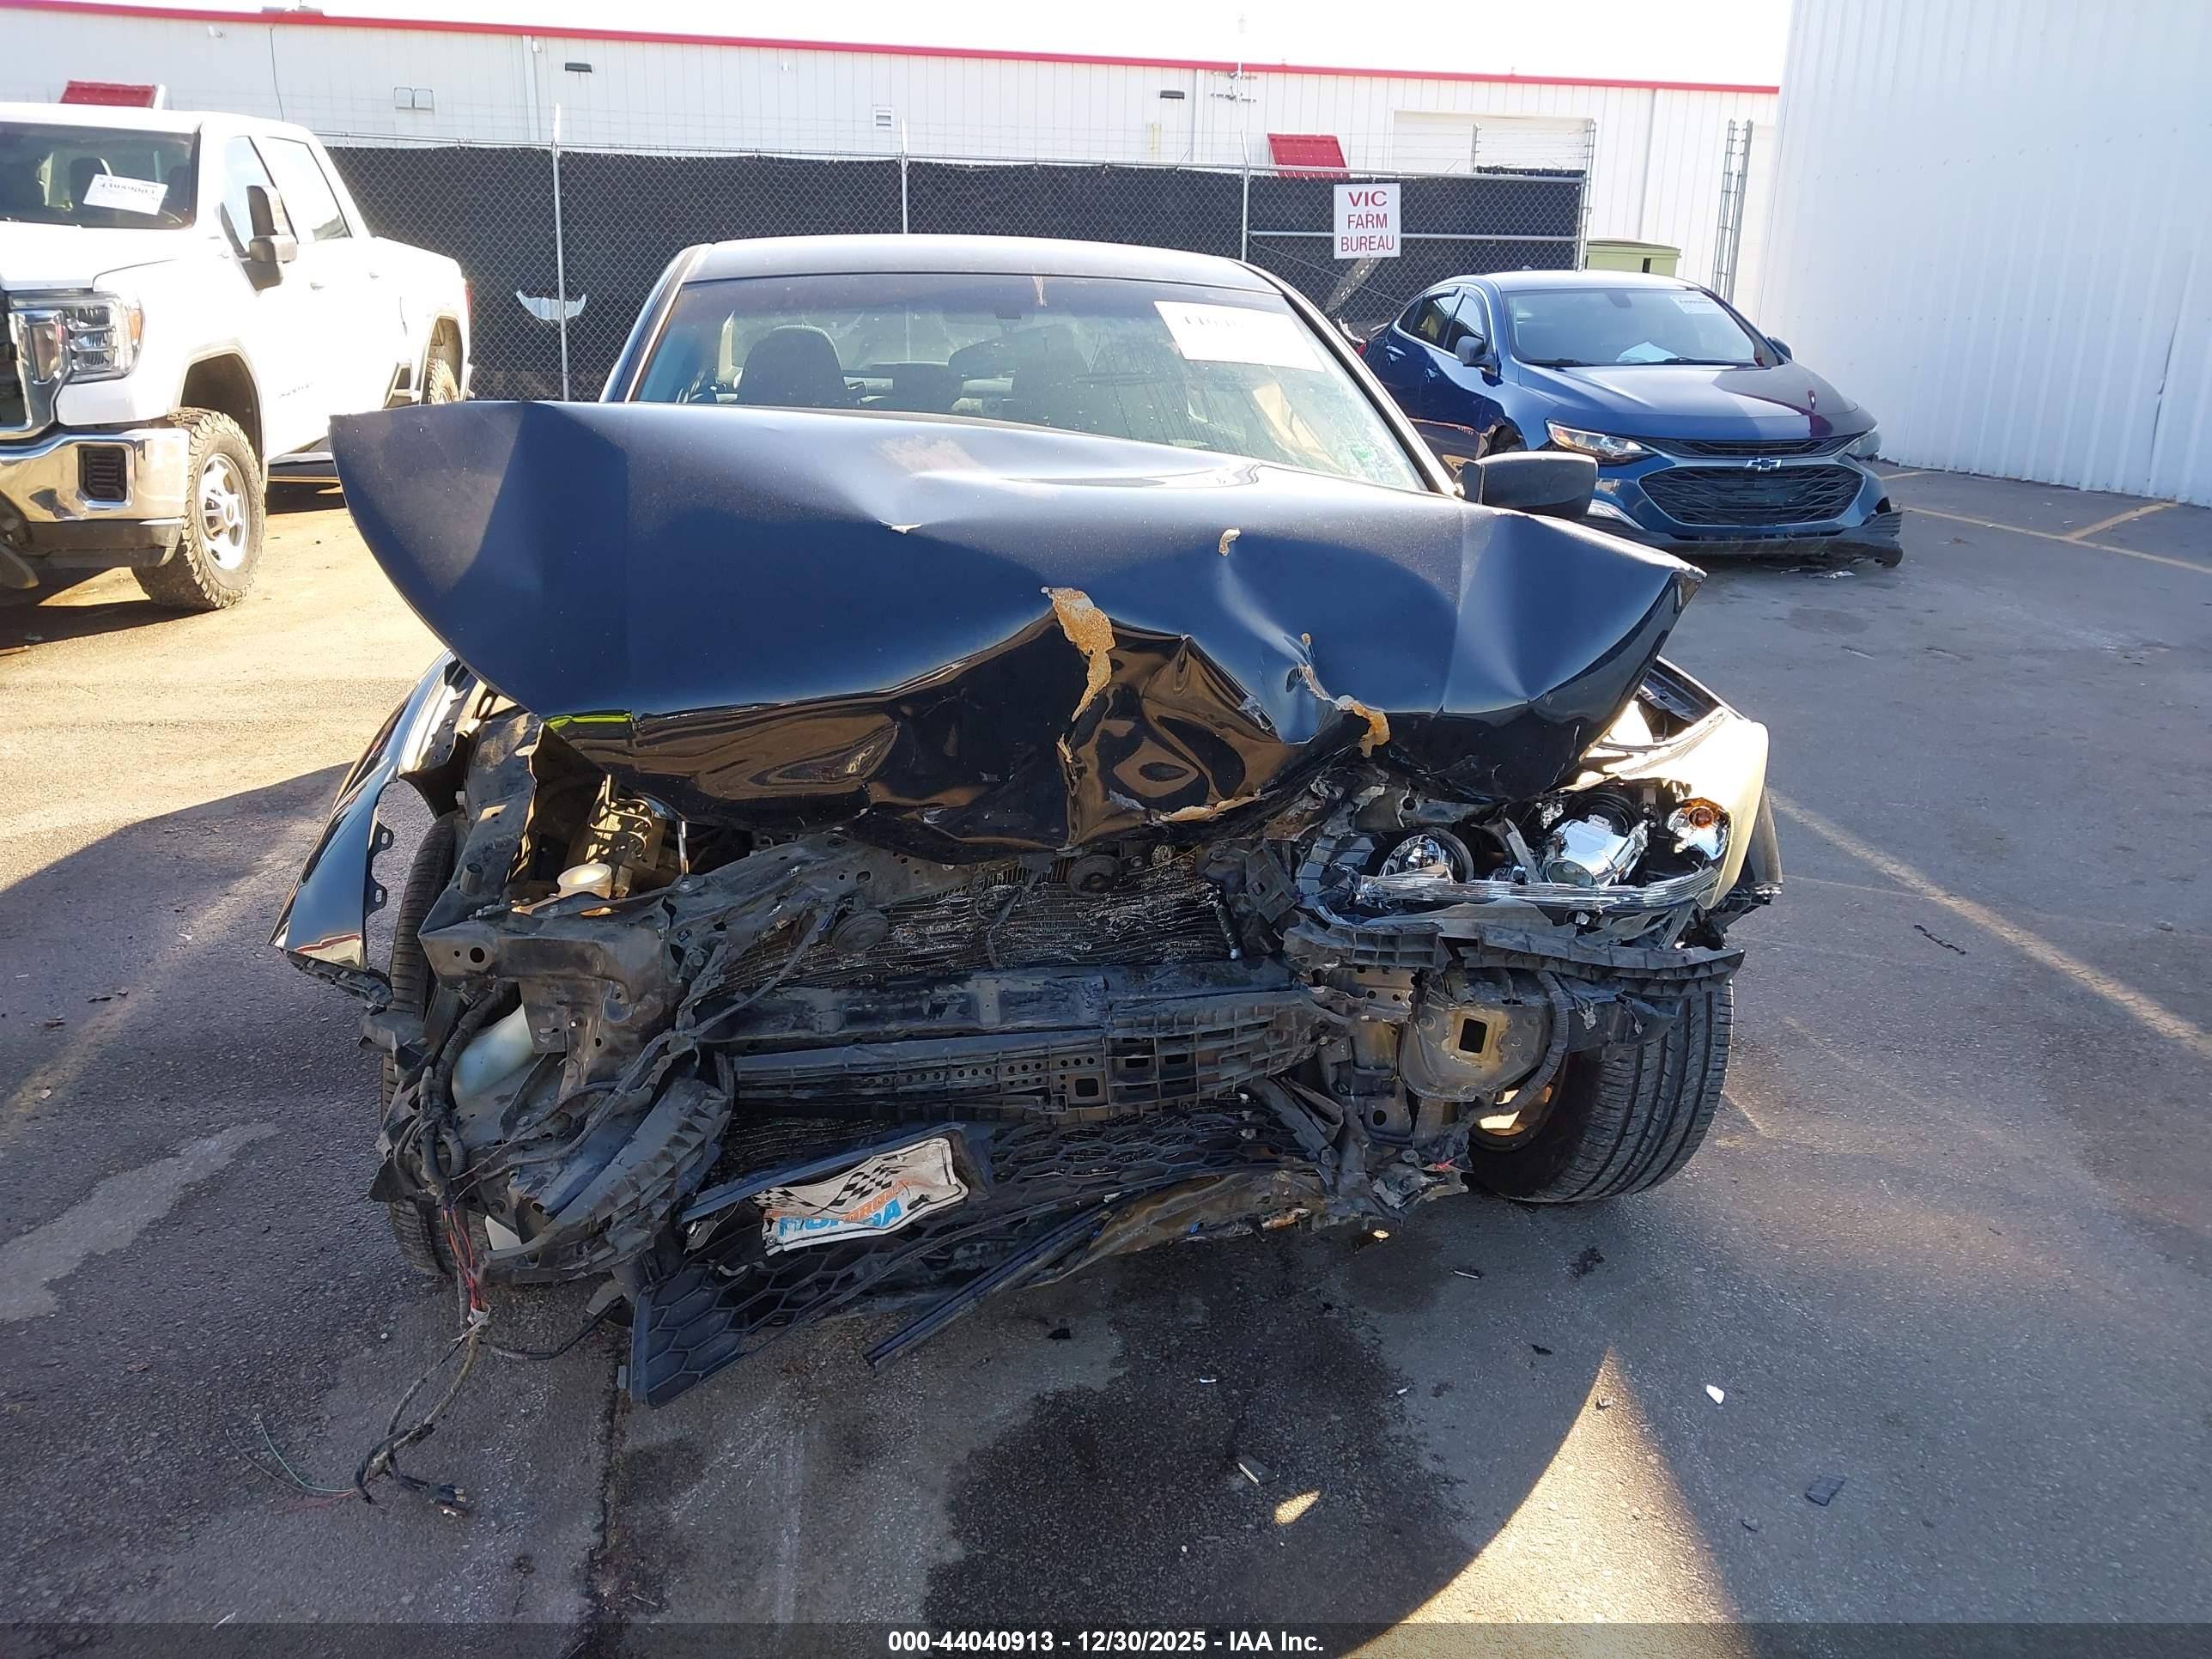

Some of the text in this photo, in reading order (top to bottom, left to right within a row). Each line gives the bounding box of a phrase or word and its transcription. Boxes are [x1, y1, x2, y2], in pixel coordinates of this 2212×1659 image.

[1347, 191, 1388, 207] VIC
[1347, 213, 1388, 229] FARM
[1340, 235, 1395, 252] BUREAU
